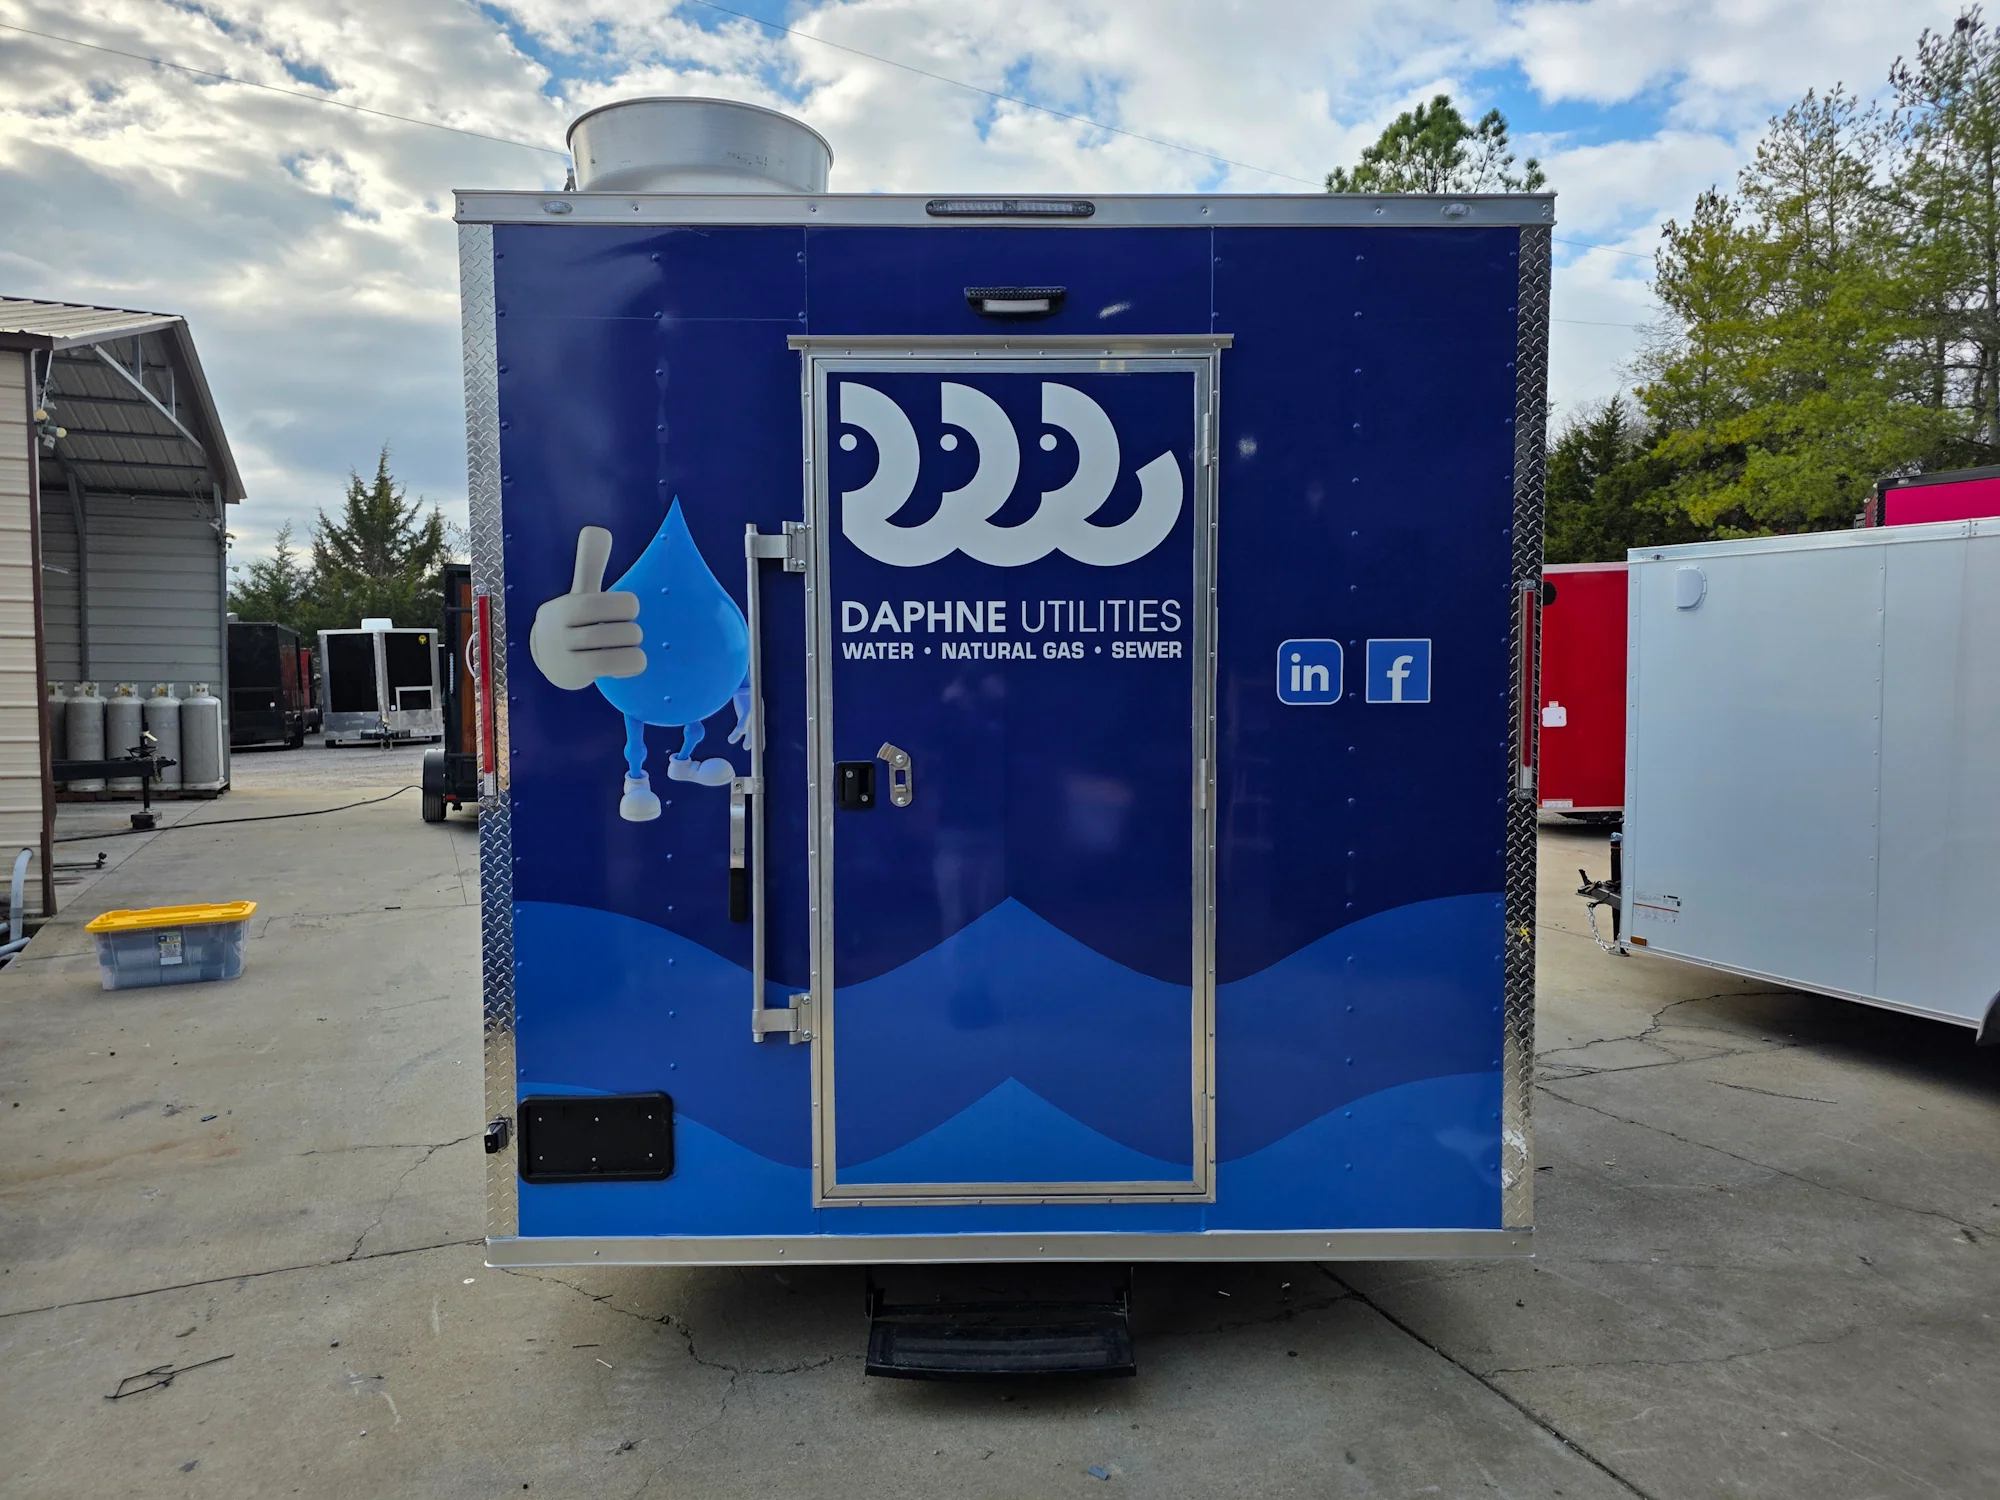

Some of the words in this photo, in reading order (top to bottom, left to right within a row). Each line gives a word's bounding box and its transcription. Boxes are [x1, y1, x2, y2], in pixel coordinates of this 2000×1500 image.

[841, 600, 1007, 633] DAPHNE
[1021, 599, 1182, 633] UTILITIES
[841, 642, 914, 660] WATER
[941, 641, 1037, 660] NATURAL
[1042, 641, 1085, 660] GAS
[1111, 640, 1182, 659] SEWER
[1290, 652, 1330, 692] in
[1386, 655, 1414, 702] f
